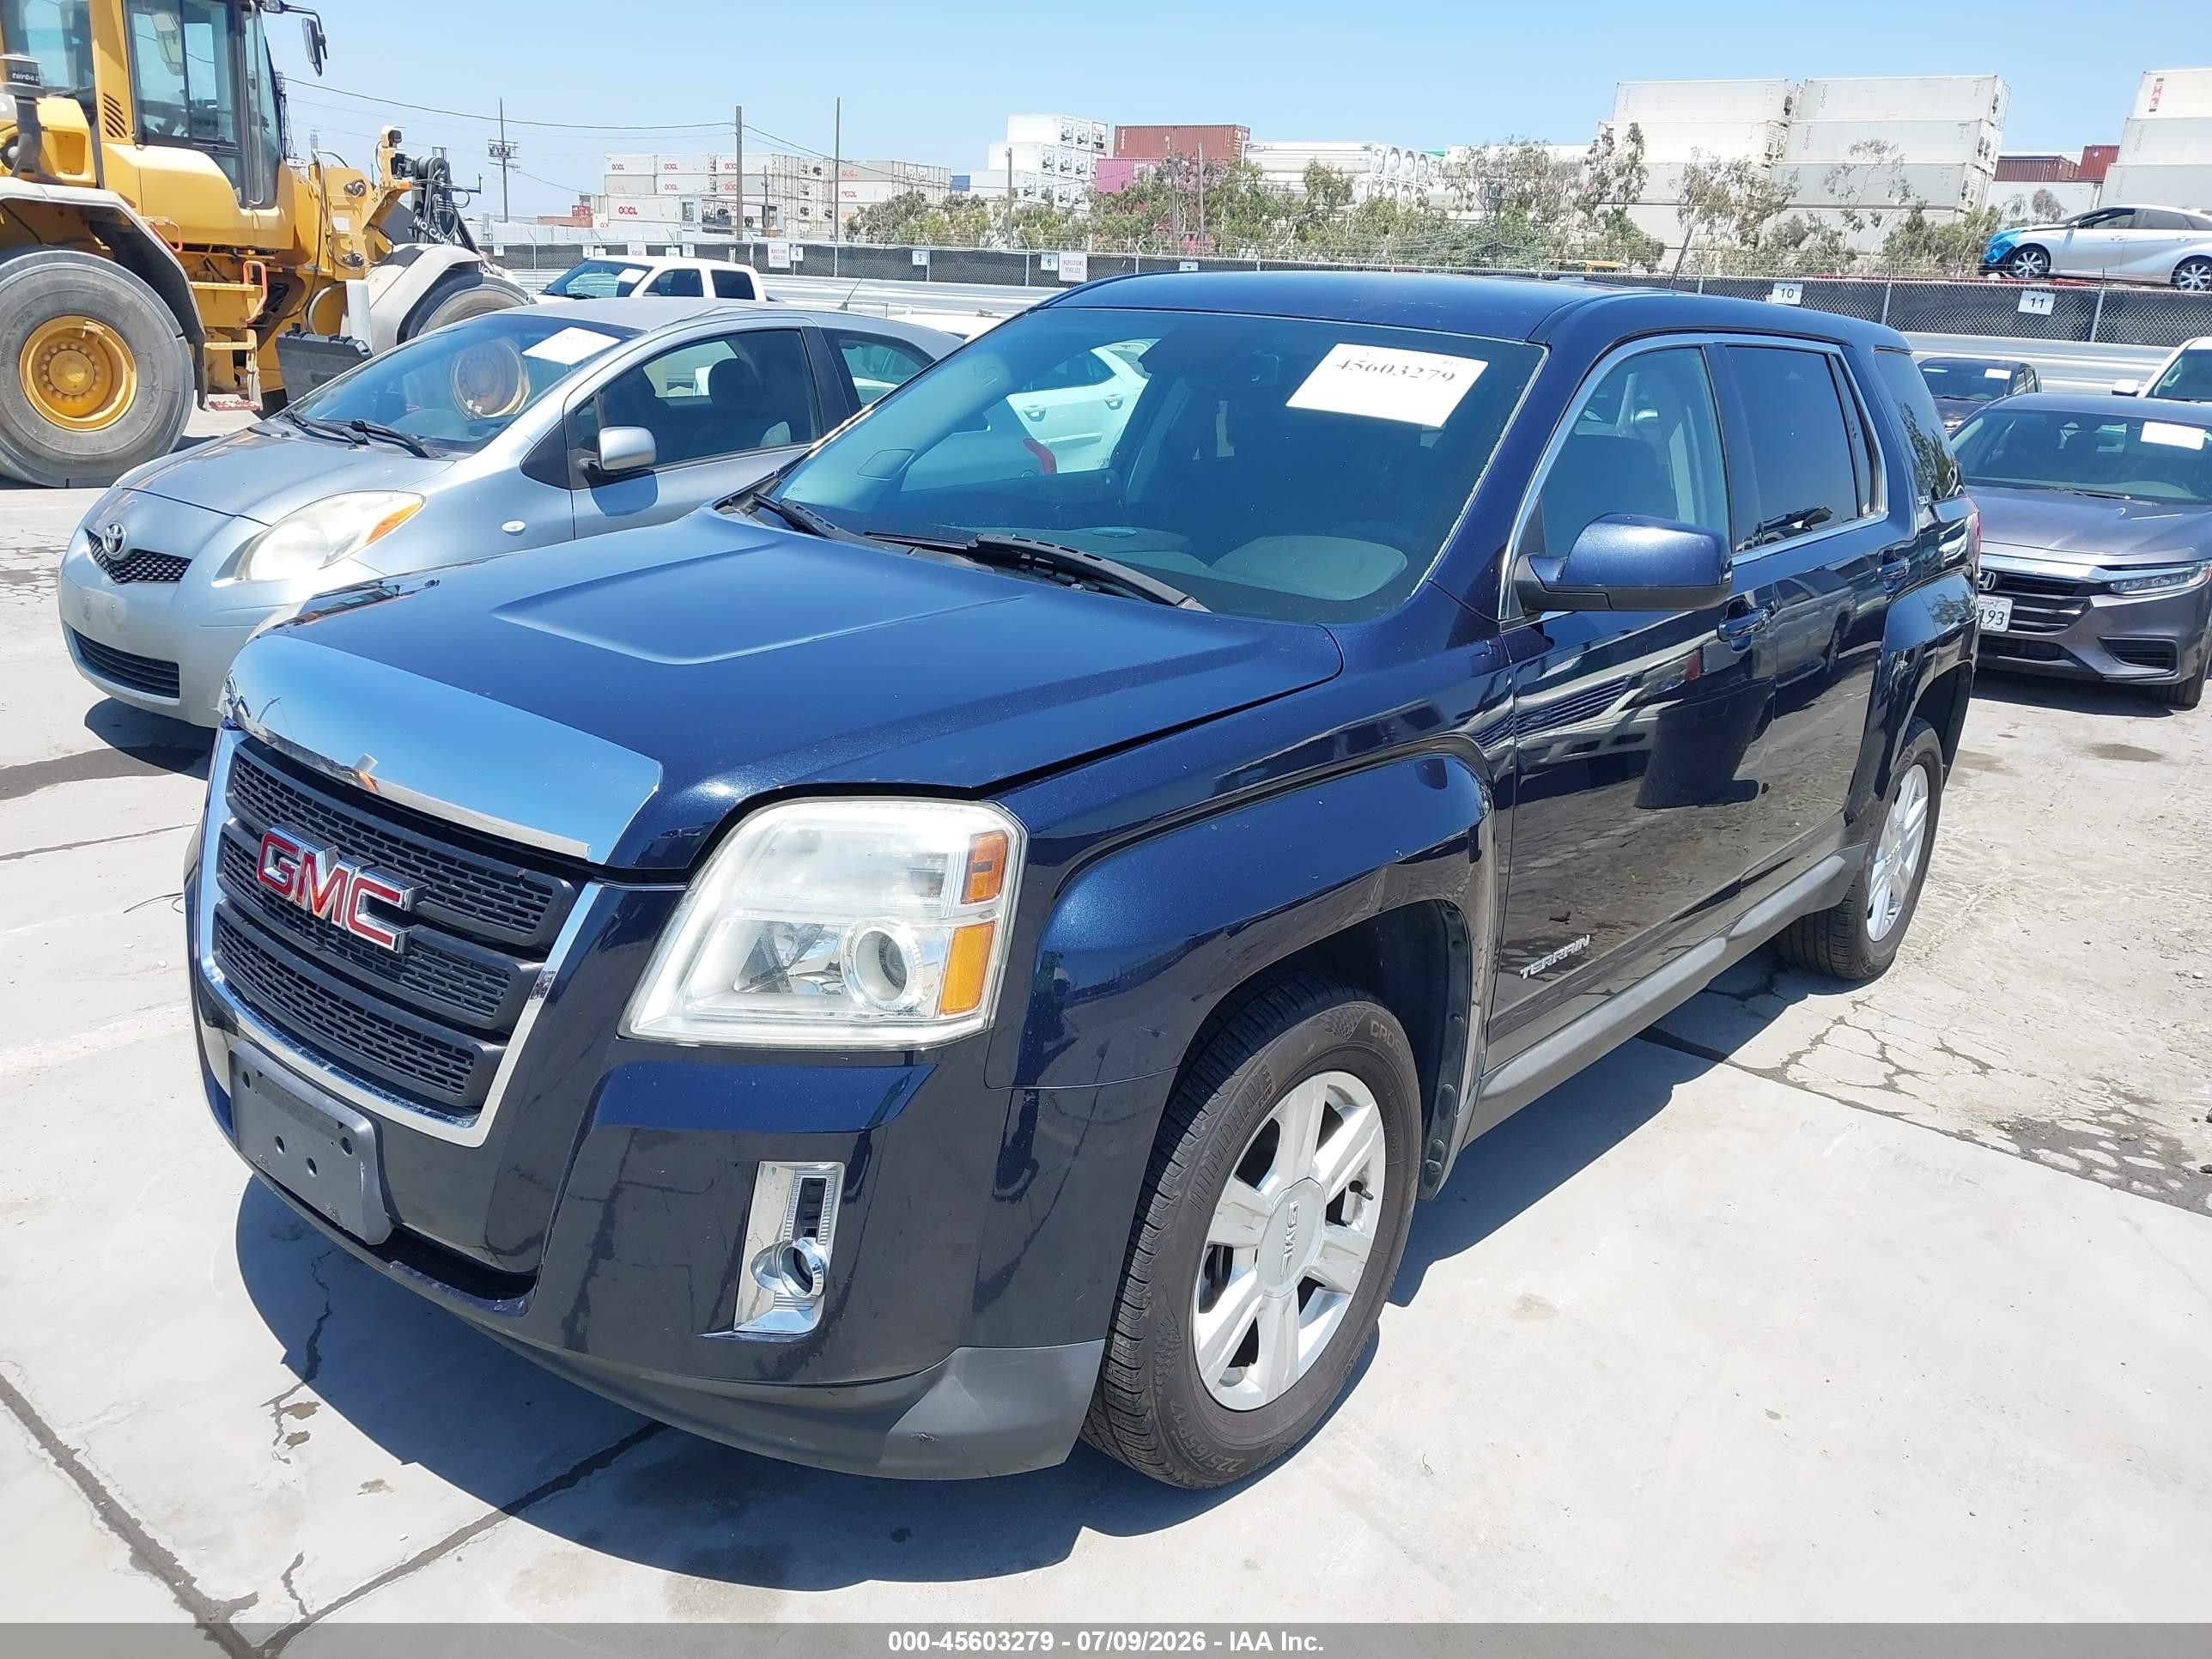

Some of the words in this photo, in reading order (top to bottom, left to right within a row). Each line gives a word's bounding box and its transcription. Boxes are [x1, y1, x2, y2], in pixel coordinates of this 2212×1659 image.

[618, 205, 638, 215] OOCL
[1047, 258, 1053, 267] 6
[1780, 288, 1795, 299] 10
[2030, 296, 2045, 309] 11
[1334, 359, 1456, 382] 45603279
[257, 825, 414, 954] GMC
[1519, 933, 1590, 980] TERRAIN
[1279, 1200, 1299, 1278] GMC
